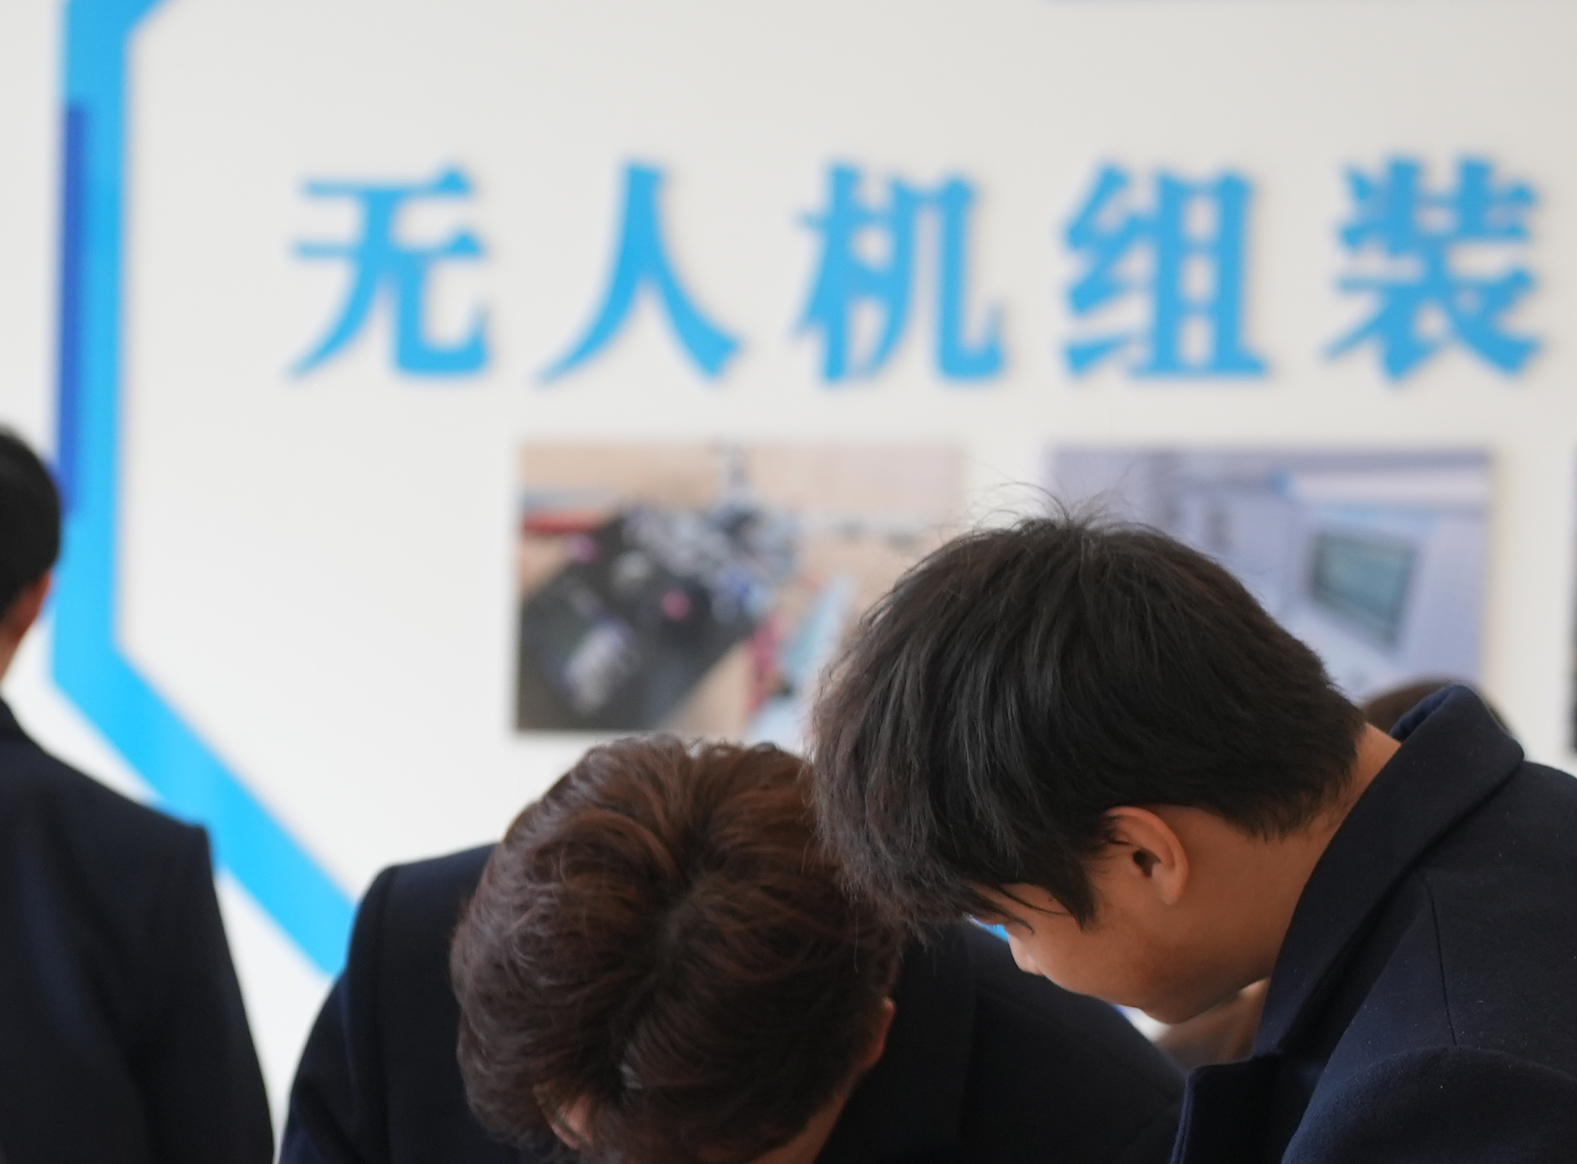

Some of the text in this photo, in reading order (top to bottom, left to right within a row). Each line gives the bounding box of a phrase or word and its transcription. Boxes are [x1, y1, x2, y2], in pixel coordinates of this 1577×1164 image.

[286, 154, 1547, 386] 无人机组装
